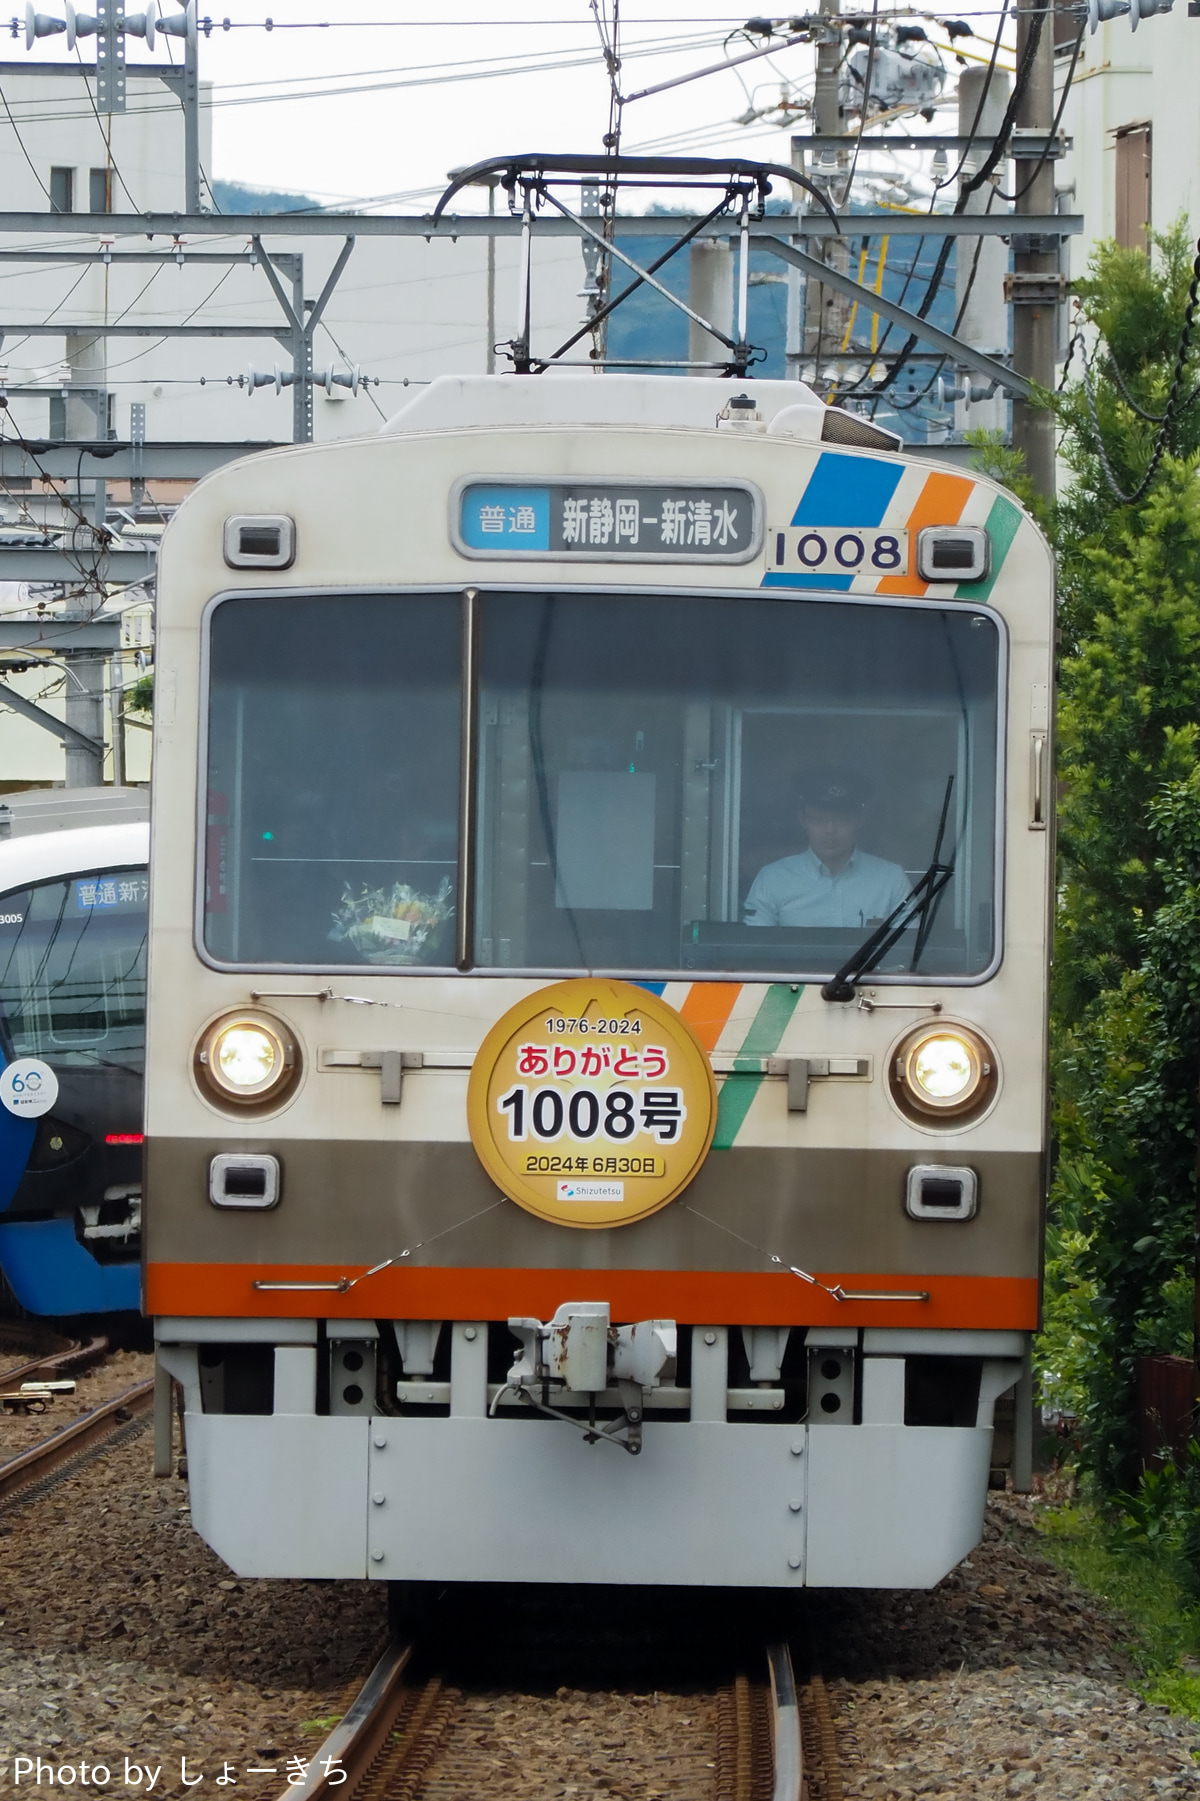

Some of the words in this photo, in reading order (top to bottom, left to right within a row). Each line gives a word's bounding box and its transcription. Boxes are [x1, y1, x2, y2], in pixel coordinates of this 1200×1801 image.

[479, 505, 536, 534] 普通
[776, 533, 902, 569] 1008
[79, 882, 118, 906] 普通
[546, 1018, 642, 1035] 1976-2024
[518, 1046, 667, 1078] ありがとう
[502, 1088, 682, 1140] 1008号
[575, 1186, 622, 1196] Shizutetsu
